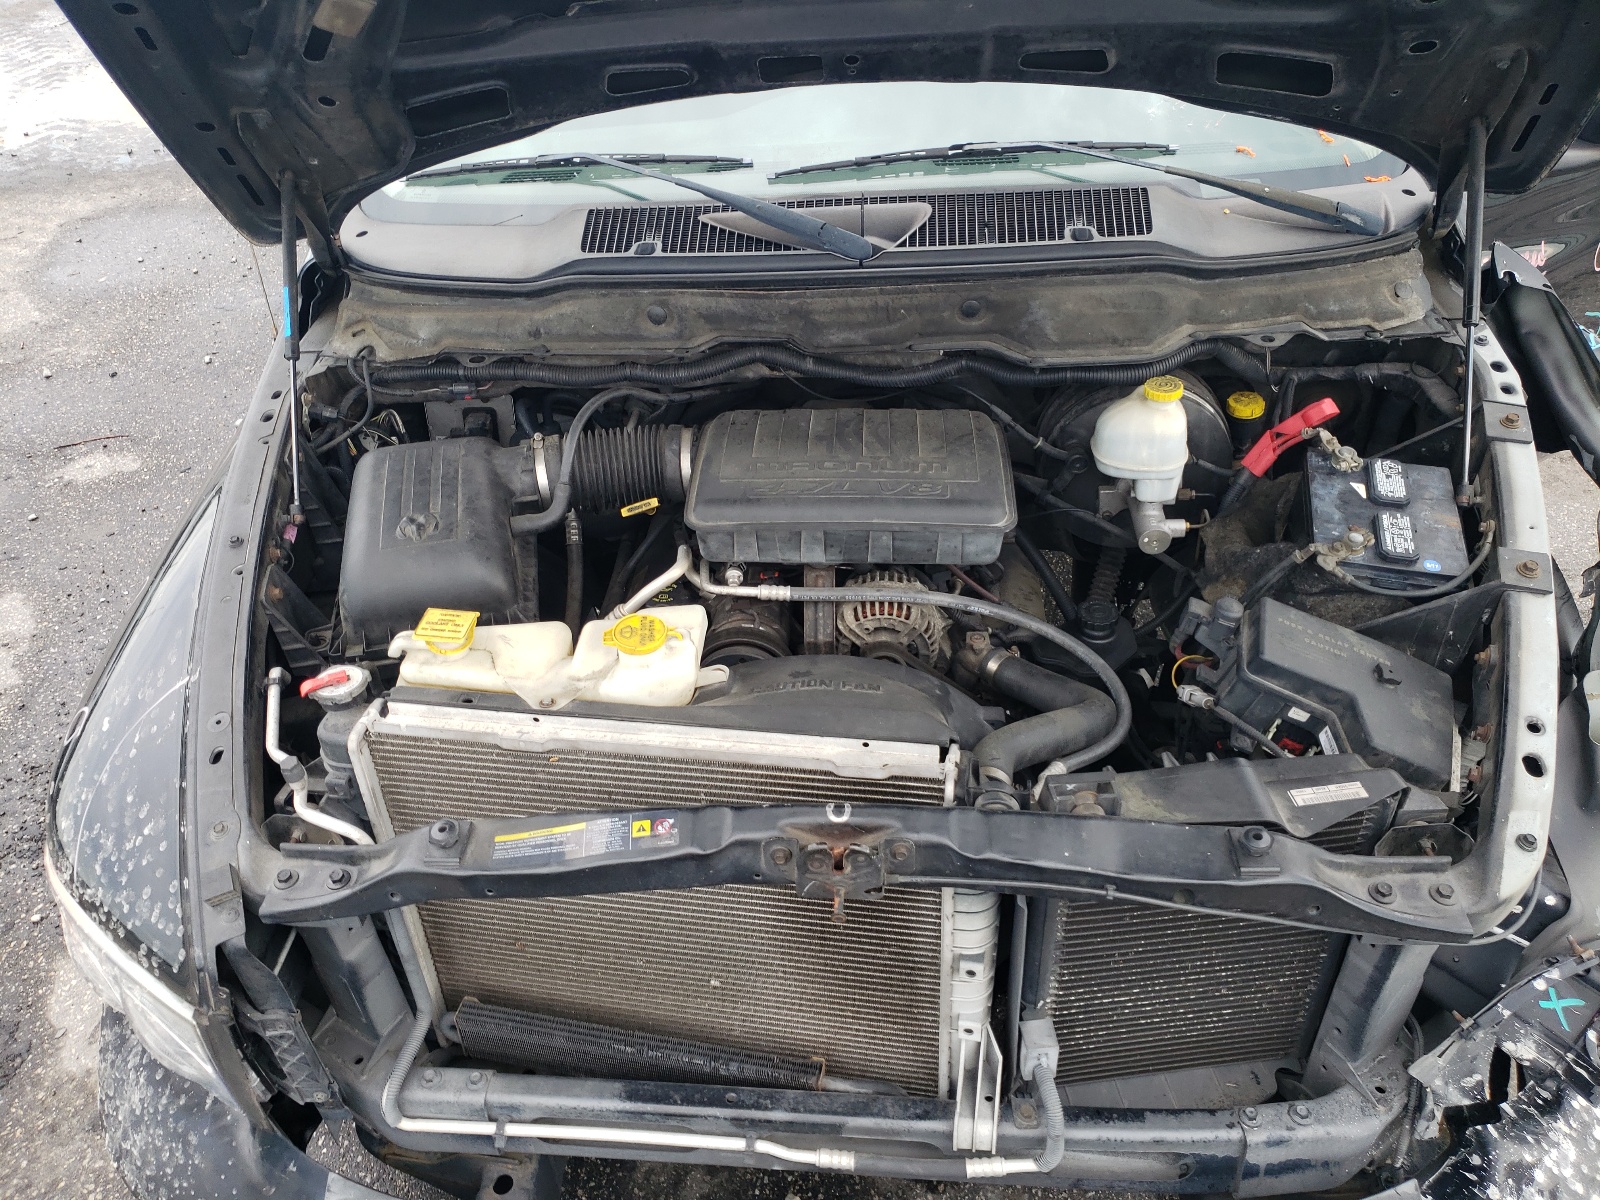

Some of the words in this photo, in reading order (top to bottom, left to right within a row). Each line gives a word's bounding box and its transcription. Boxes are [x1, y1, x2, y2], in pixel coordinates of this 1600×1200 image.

[878, 481, 943, 495] V8
[1278, 617, 1303, 631] FUSE
[1304, 636, 1348, 658] CAUTION
[840, 680, 883, 694] FAN
